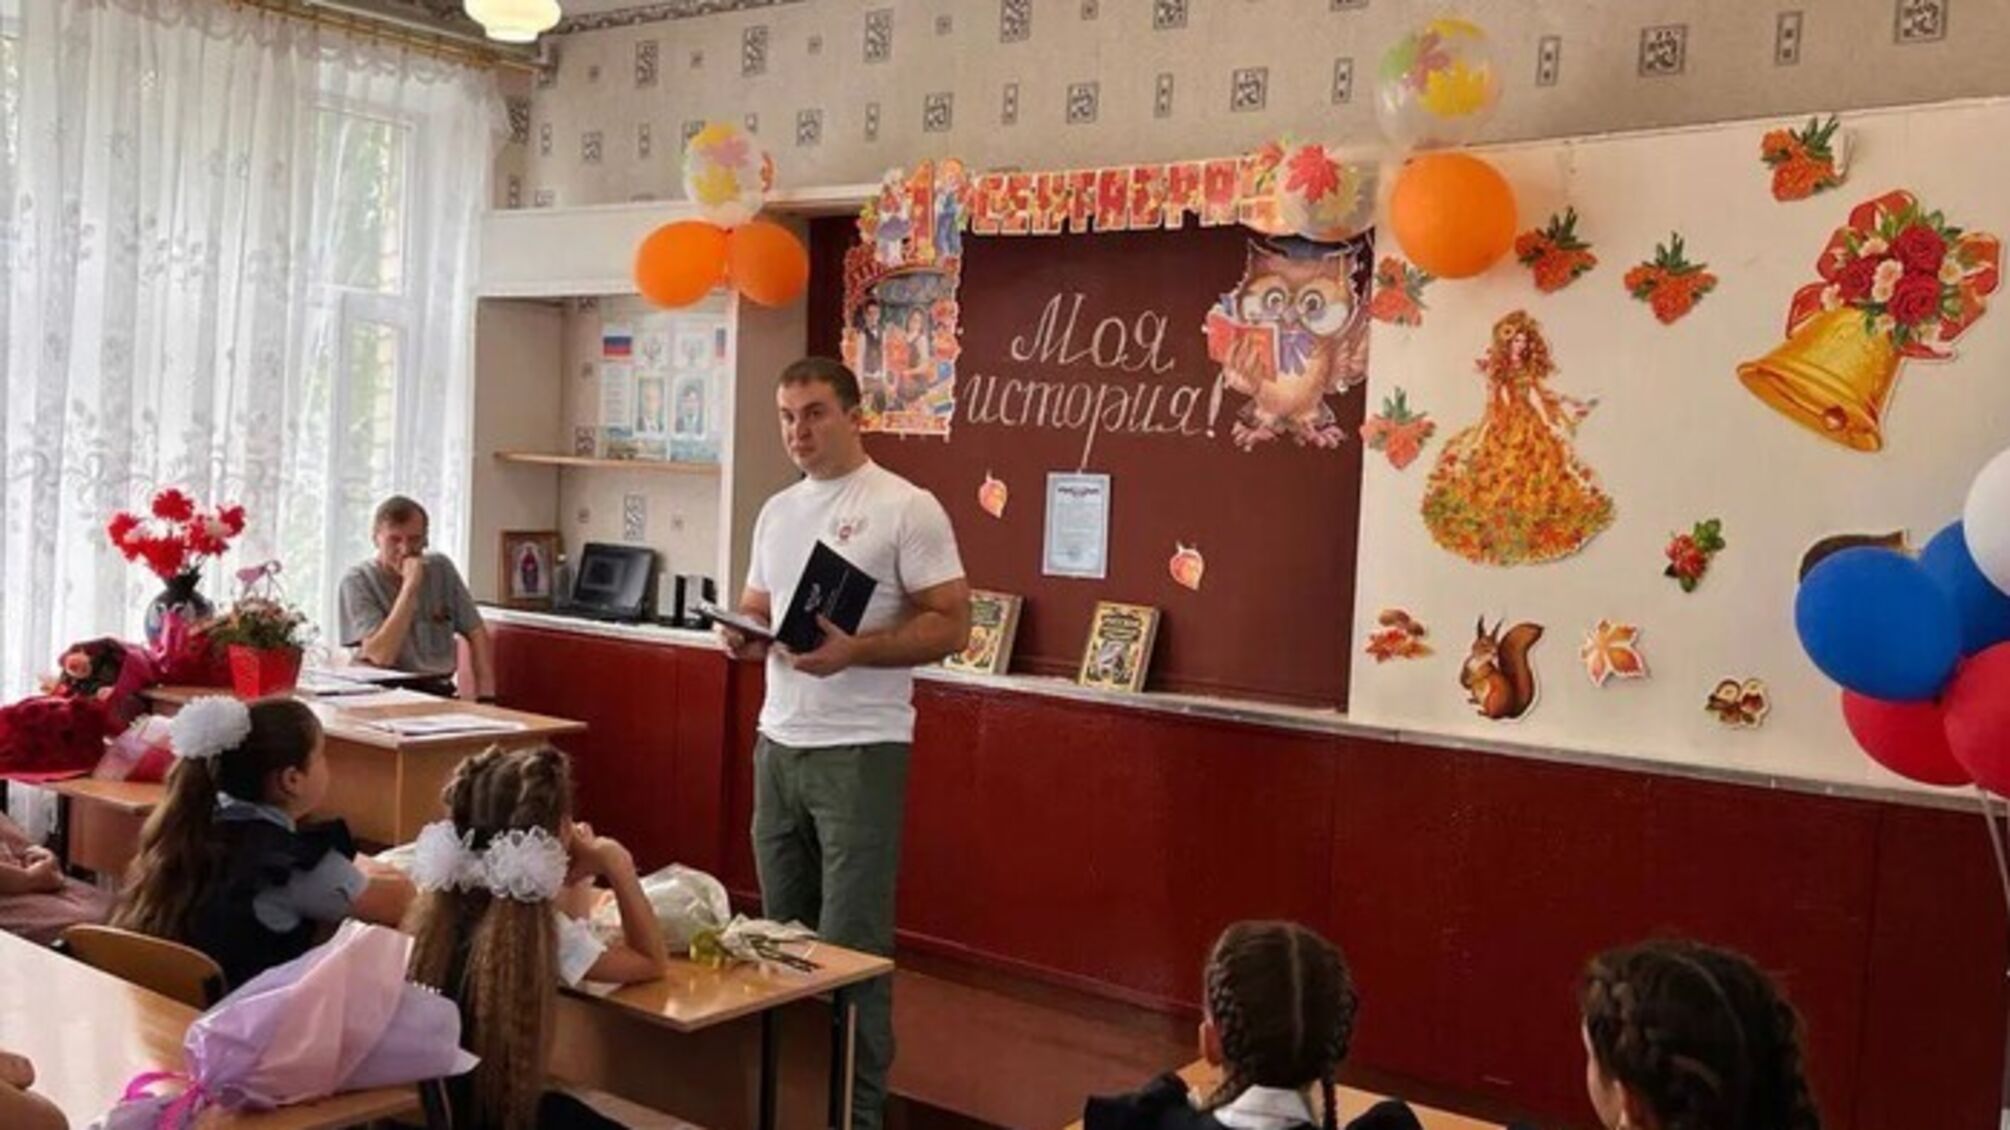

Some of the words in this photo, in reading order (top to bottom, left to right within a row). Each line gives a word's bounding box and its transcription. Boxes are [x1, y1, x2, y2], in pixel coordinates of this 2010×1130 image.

[907, 159, 935, 266] 1
[972, 159, 1240, 236] СЕНТЯБРЯ
[1011, 292, 1175, 374] Моя
[963, 370, 1224, 468] история!
